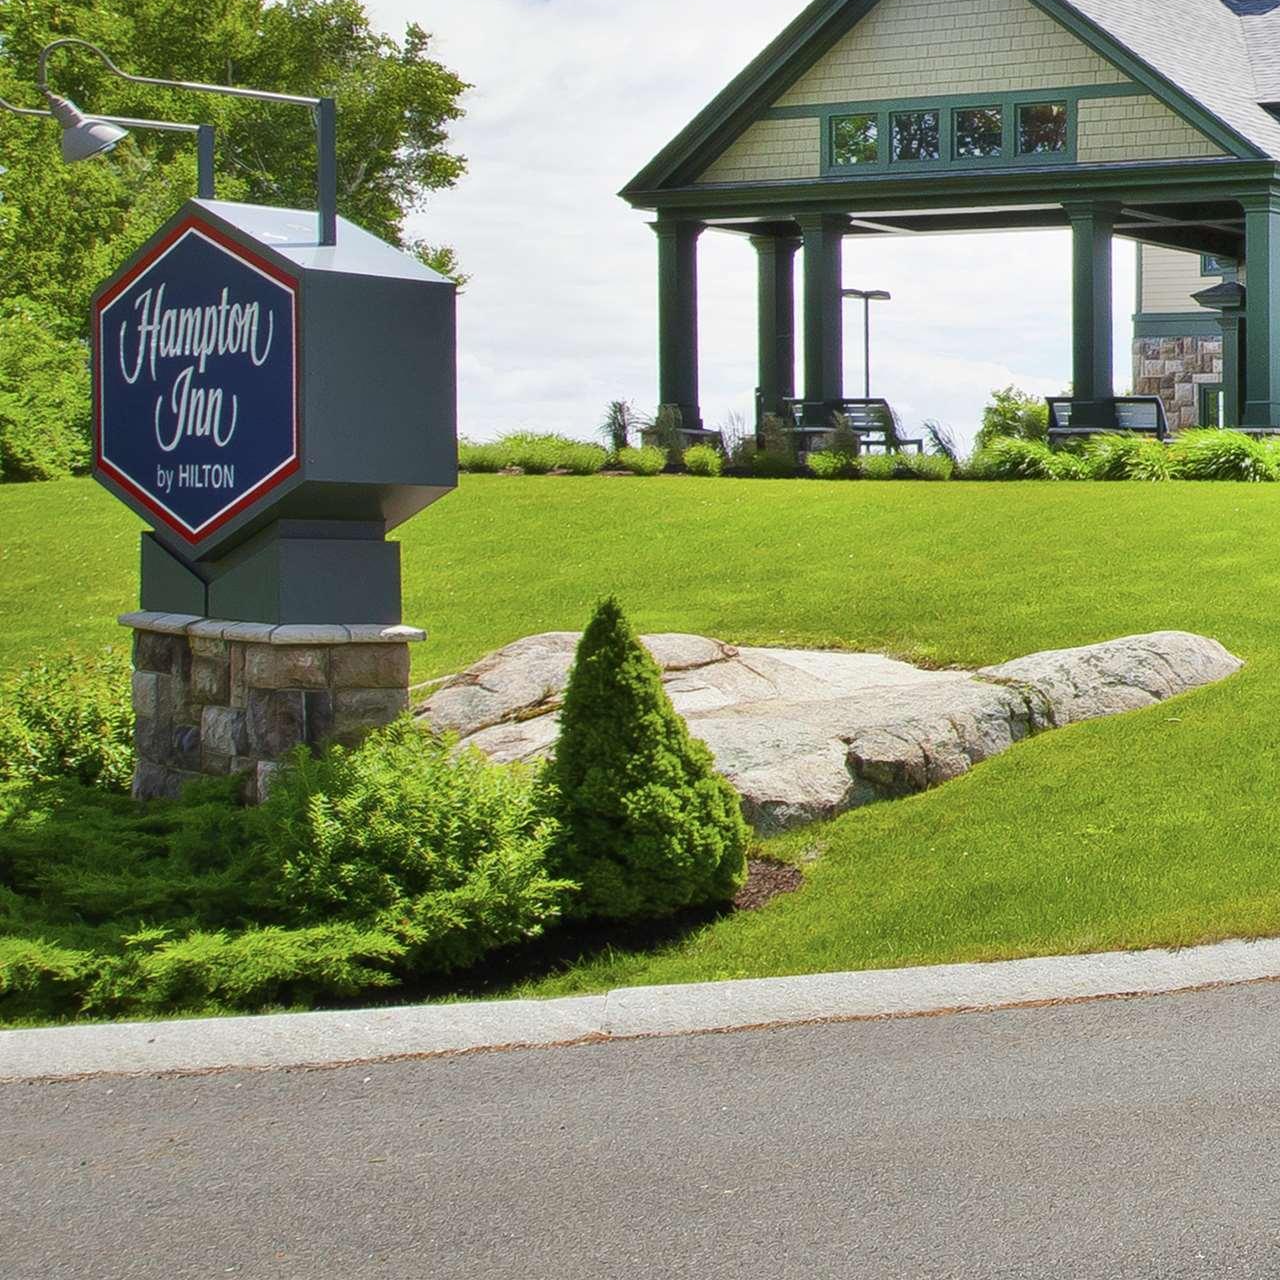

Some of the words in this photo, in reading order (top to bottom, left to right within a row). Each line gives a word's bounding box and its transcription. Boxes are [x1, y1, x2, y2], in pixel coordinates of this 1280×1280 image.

[120, 283, 274, 384] Hampton
[155, 366, 238, 452] Inn
[156, 463, 174, 494] by
[179, 464, 235, 489] HILTON
